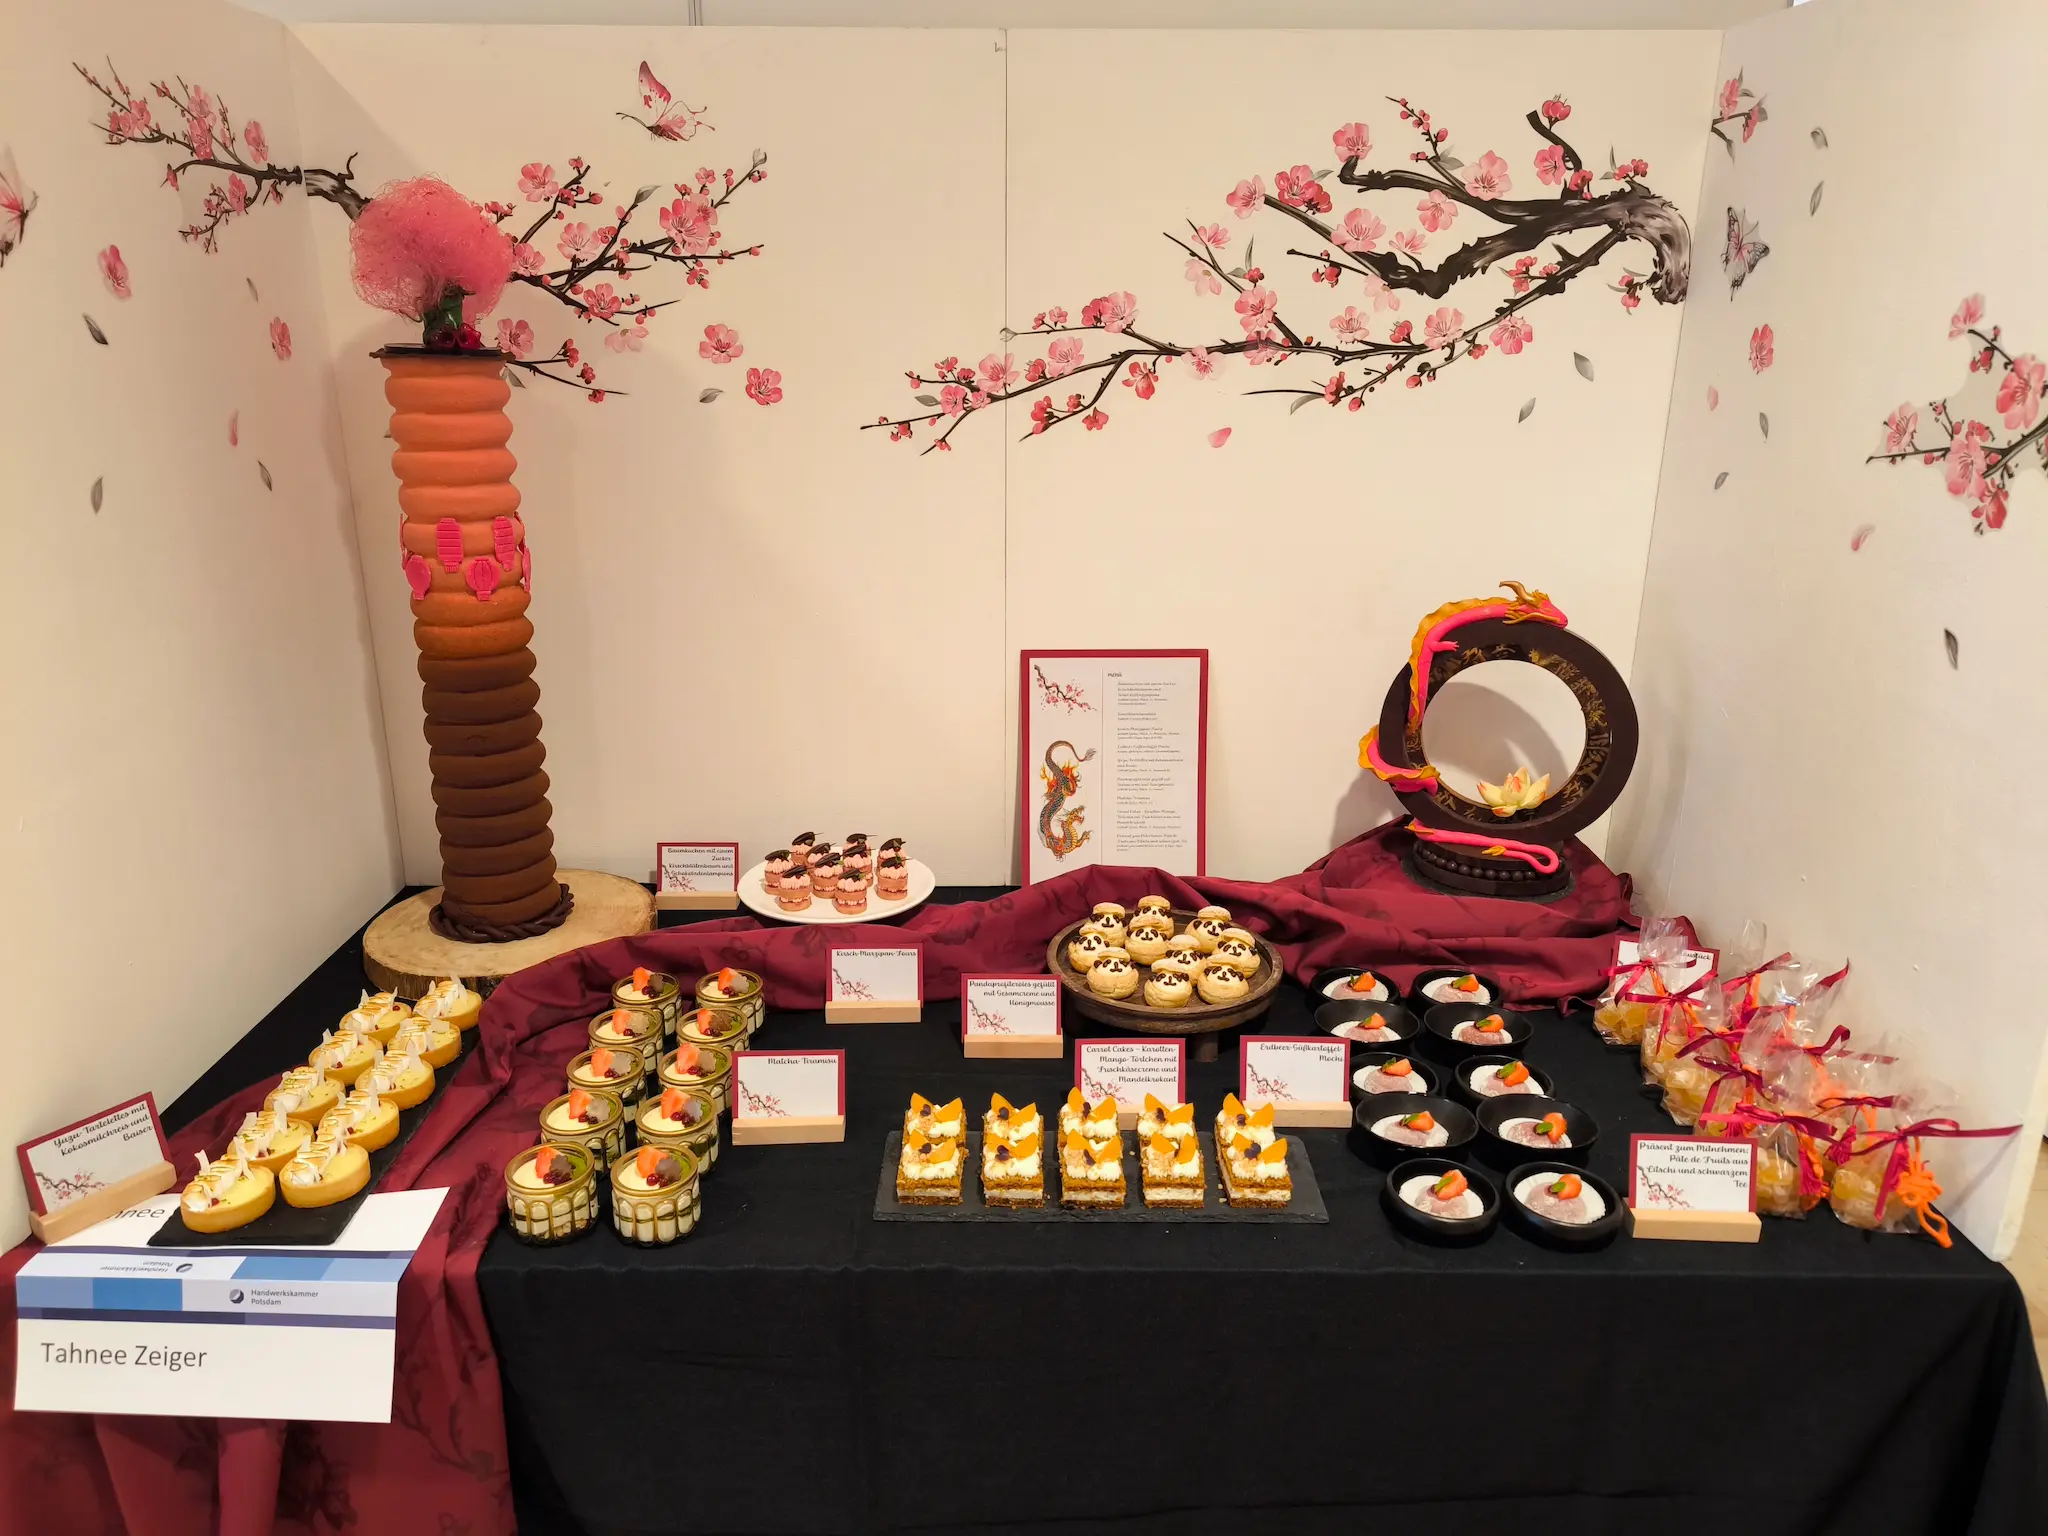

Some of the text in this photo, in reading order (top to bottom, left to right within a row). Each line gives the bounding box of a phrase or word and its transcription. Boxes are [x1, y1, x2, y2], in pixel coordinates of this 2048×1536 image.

[1033, 981, 1055, 989] gefüllt
[1260, 1043, 1343, 1053] Erdbeer-Süßkartoffel-
[53, 1103, 147, 1148] Yuzu-Tartelettes mit
[60, 1114, 150, 1156] Kokosmilchreis und
[122, 1125, 153, 1142] Baiser
[1639, 1141, 1749, 1154] Präsent zum Mitnehmen:
[1690, 1155, 1702, 1163] de
[1703, 1156, 1731, 1165] Fruits
[1646, 1165, 1748, 1178] Litschi und schwarzem
[1732, 1179, 1748, 1188] Tee
[251, 1289, 319, 1298] Handwerkskammer
[251, 1298, 282, 1306] Potsdam
[41, 1342, 207, 1372] Tahnee Zeiger
